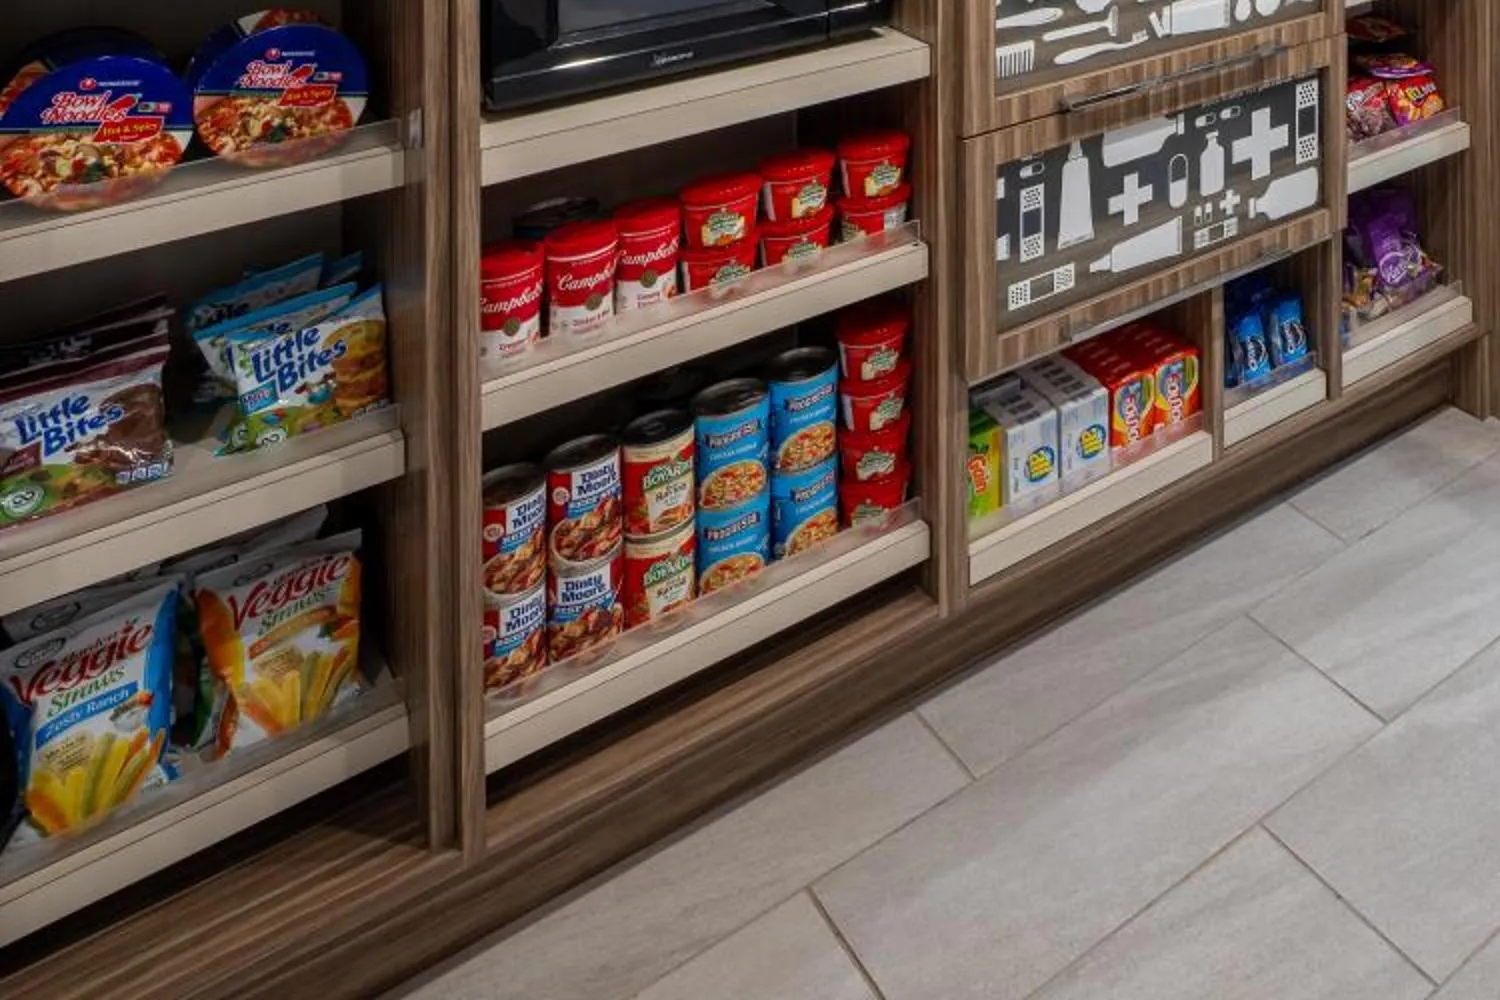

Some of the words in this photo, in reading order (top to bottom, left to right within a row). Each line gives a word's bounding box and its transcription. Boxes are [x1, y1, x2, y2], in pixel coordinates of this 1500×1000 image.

[252, 327, 321, 384] Little
[277, 339, 348, 393] Bites
[15, 394, 91, 445] Little
[43, 403, 126, 458] Bites
[227, 554, 351, 632] Veggie
[9, 621, 153, 707] Veggie
